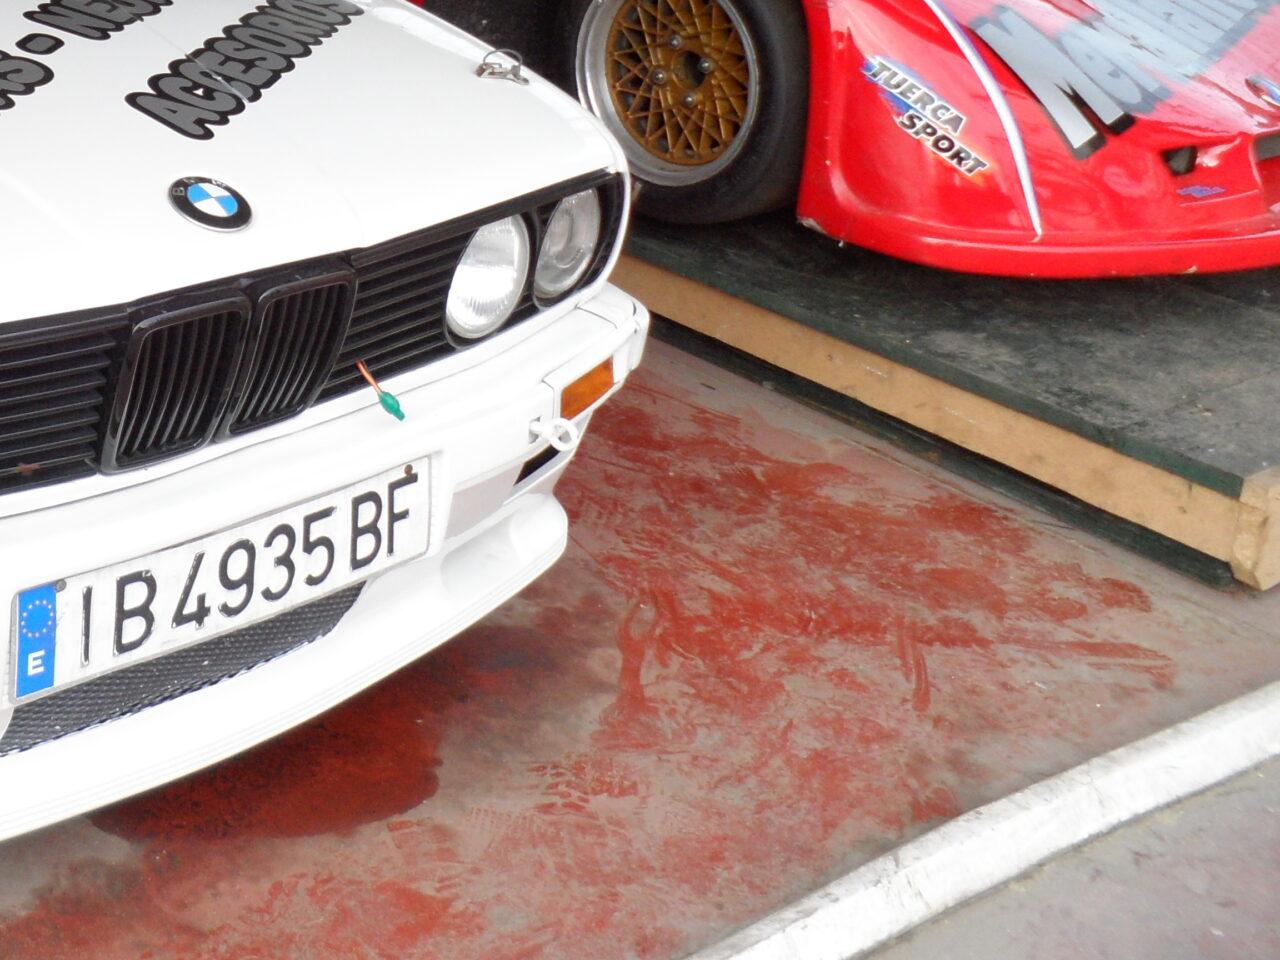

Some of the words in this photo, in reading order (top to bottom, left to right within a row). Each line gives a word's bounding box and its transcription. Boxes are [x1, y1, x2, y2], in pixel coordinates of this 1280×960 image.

[867, 57, 967, 136] TUERCA
[896, 111, 990, 176] SPORT
[27, 649, 45, 675] E
